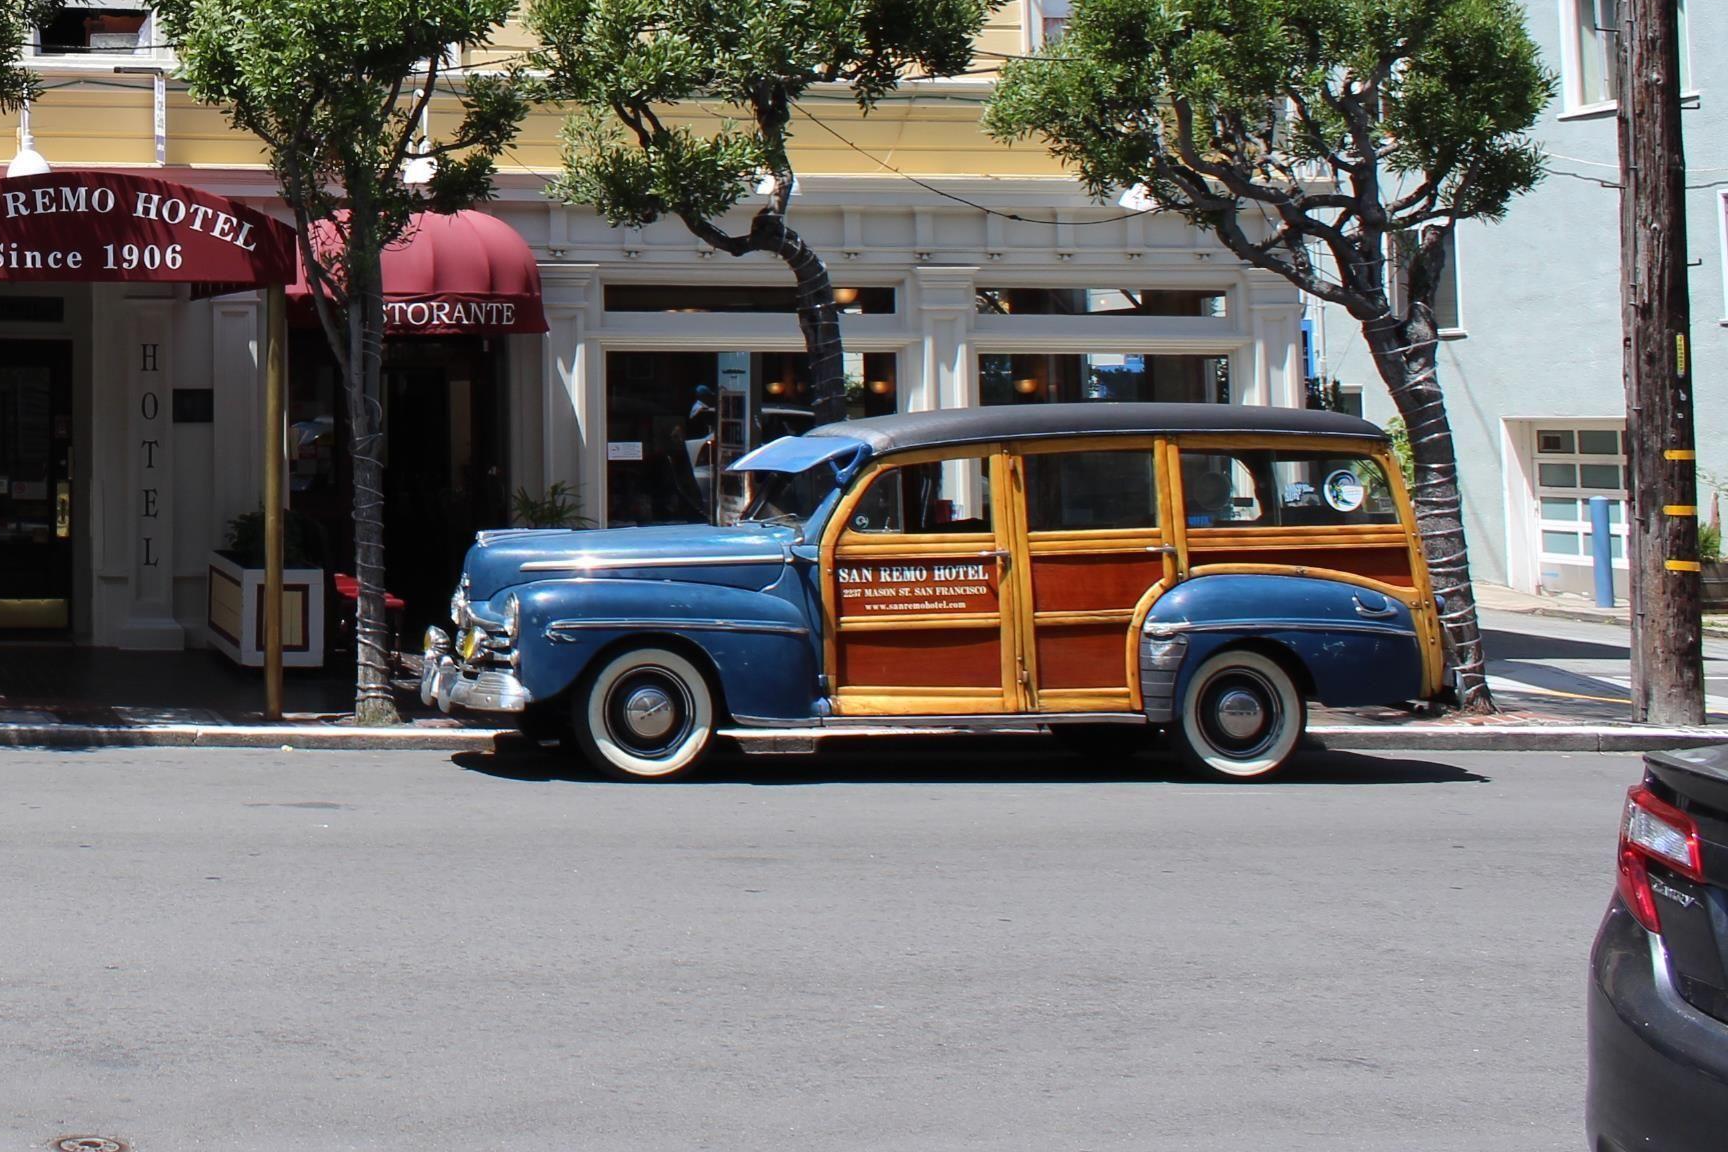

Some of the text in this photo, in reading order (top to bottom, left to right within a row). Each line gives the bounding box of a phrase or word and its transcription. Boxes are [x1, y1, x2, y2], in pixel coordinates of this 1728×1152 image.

[4, 186, 116, 219] REMO
[131, 191, 258, 252] HOTEL
[102, 243, 184, 271] 1906
[140, 343, 160, 567] HOTEL
[838, 564, 989, 583] SAN REMO HOTEL
[843, 588, 862, 598] 2237
[864, 587, 896, 597] MASON
[914, 587, 934, 597] SAN
[936, 586, 987, 596] FRANCISCO
[865, 600, 966, 611] www.sanremohotel.com
